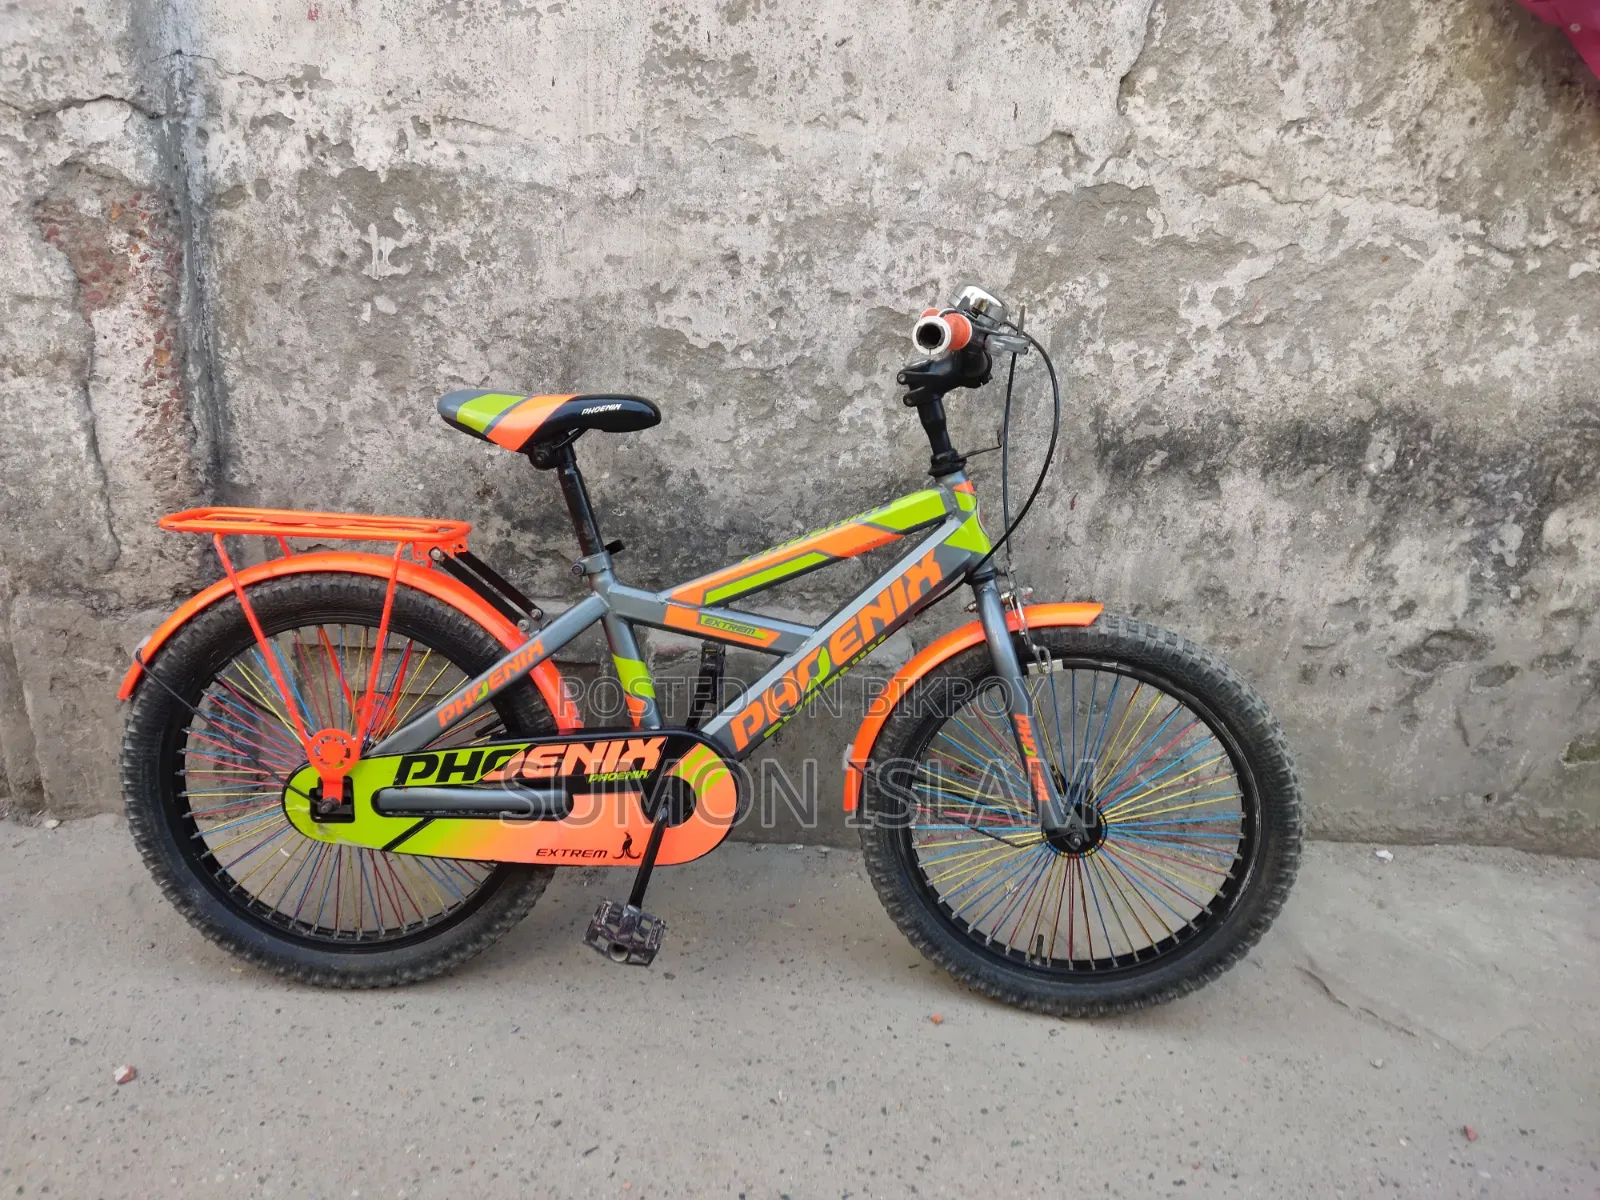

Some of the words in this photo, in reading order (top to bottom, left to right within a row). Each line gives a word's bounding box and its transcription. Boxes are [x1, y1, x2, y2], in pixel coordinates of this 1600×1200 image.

[436, 638, 545, 729] PHOENIX
[728, 548, 943, 752] PHOENIX
[394, 737, 666, 785] PHOENIX
[535, 848, 608, 859] EXTREM
